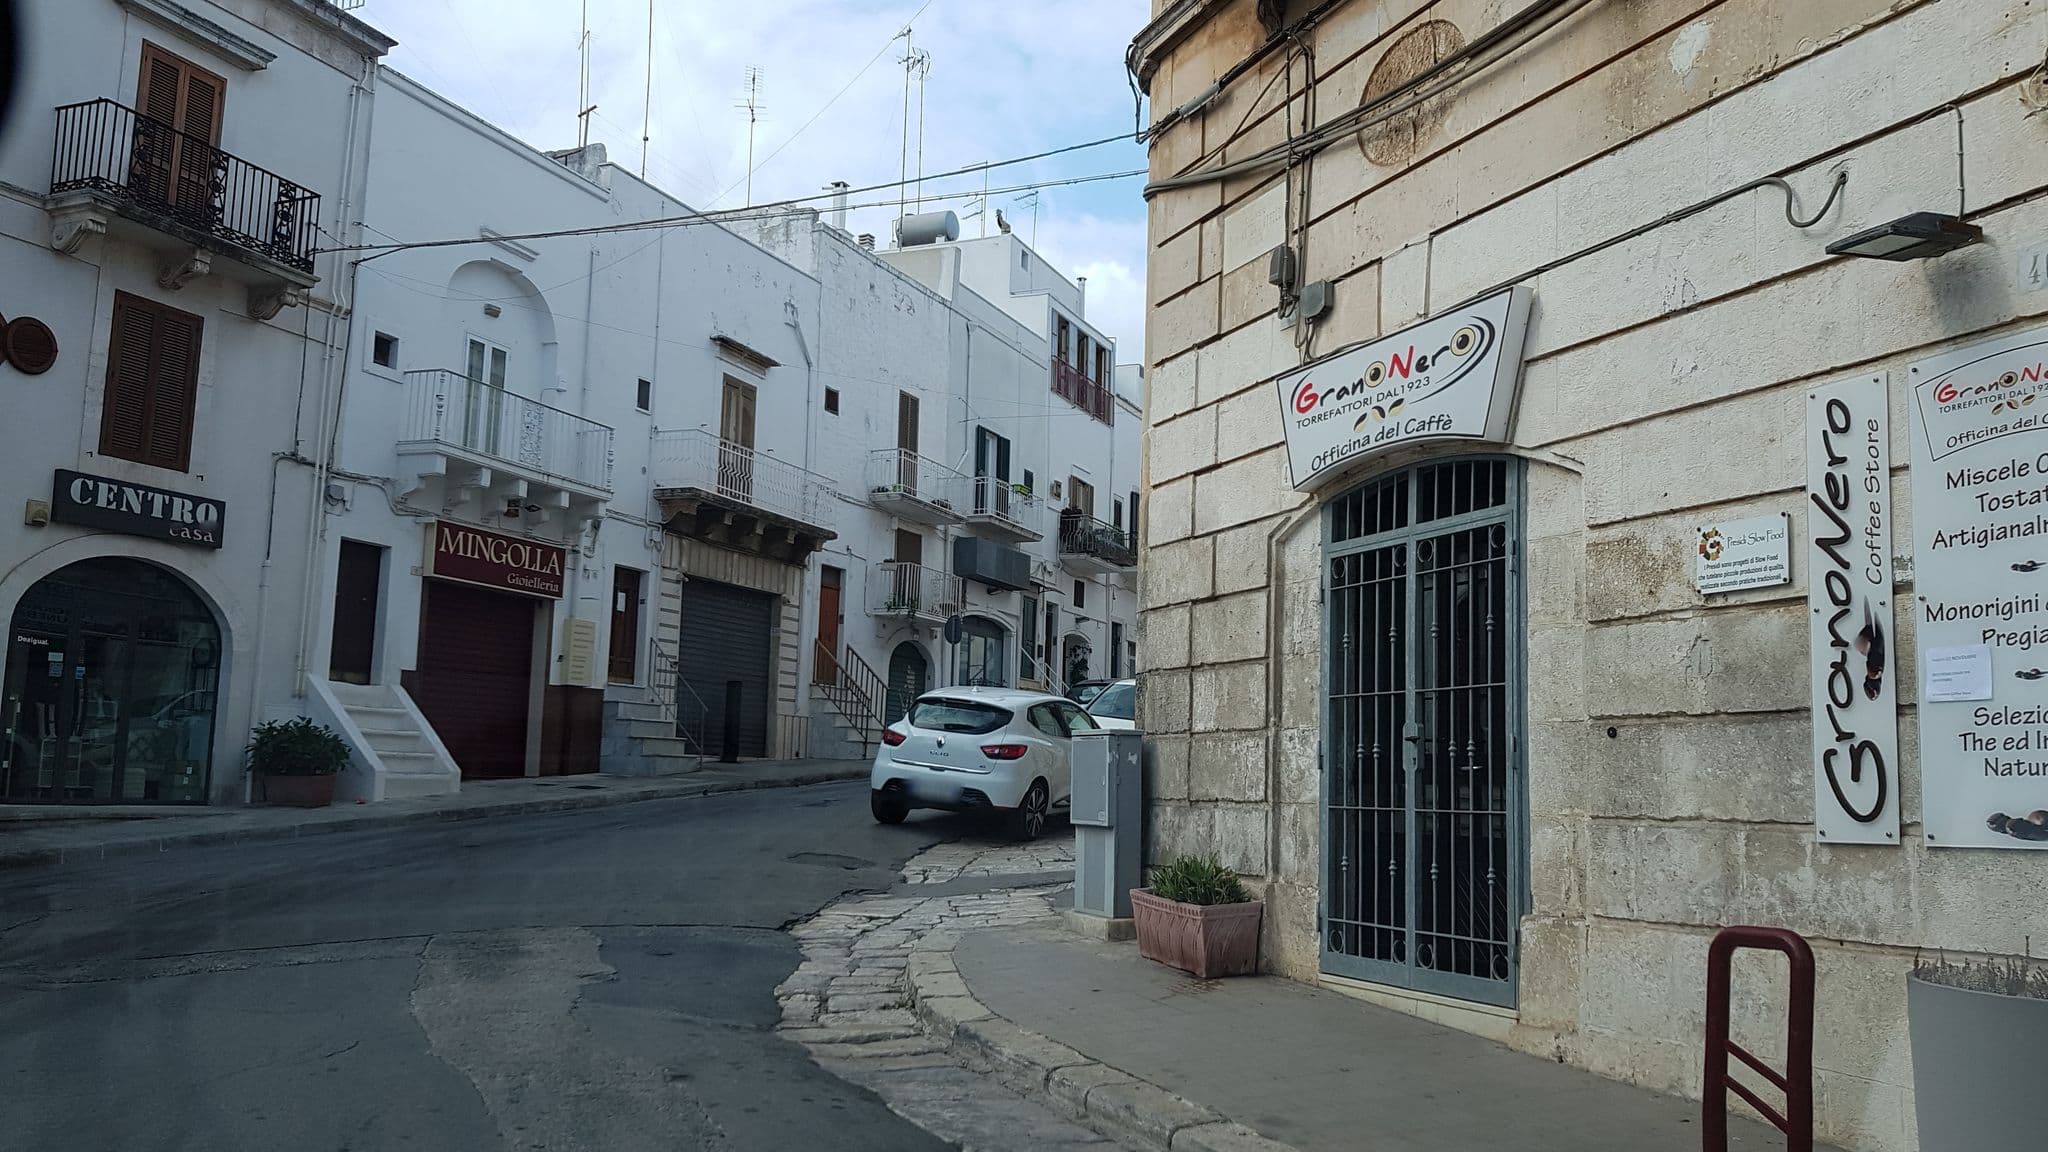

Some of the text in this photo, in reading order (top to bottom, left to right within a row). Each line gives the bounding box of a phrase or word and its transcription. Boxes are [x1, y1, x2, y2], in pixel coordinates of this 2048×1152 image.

[1296, 396, 1373, 429] TORREFATTORI
[1939, 393, 2006, 414] TORREFATTORI
[2009, 388, 2027, 398] DAL
[1311, 414, 1453, 472] Officina del Caffè
[1946, 424, 2008, 448] Officina
[2012, 415, 2037, 430] del
[1946, 459, 2030, 490] Miscele
[70, 478, 218, 525] CENTRO
[1864, 418, 1882, 584] Coffee Store
[169, 526, 215, 543] casa
[1747, 531, 1766, 546] Slow
[1766, 528, 1784, 542] Food
[439, 527, 561, 576] MINGOLLA
[1766, 553, 1779, 561] Food
[507, 573, 560, 593] Gioielleria
[1926, 593, 2039, 622] Monorigini
[1958, 732, 1997, 751] The
[2003, 730, 2029, 751] ed
